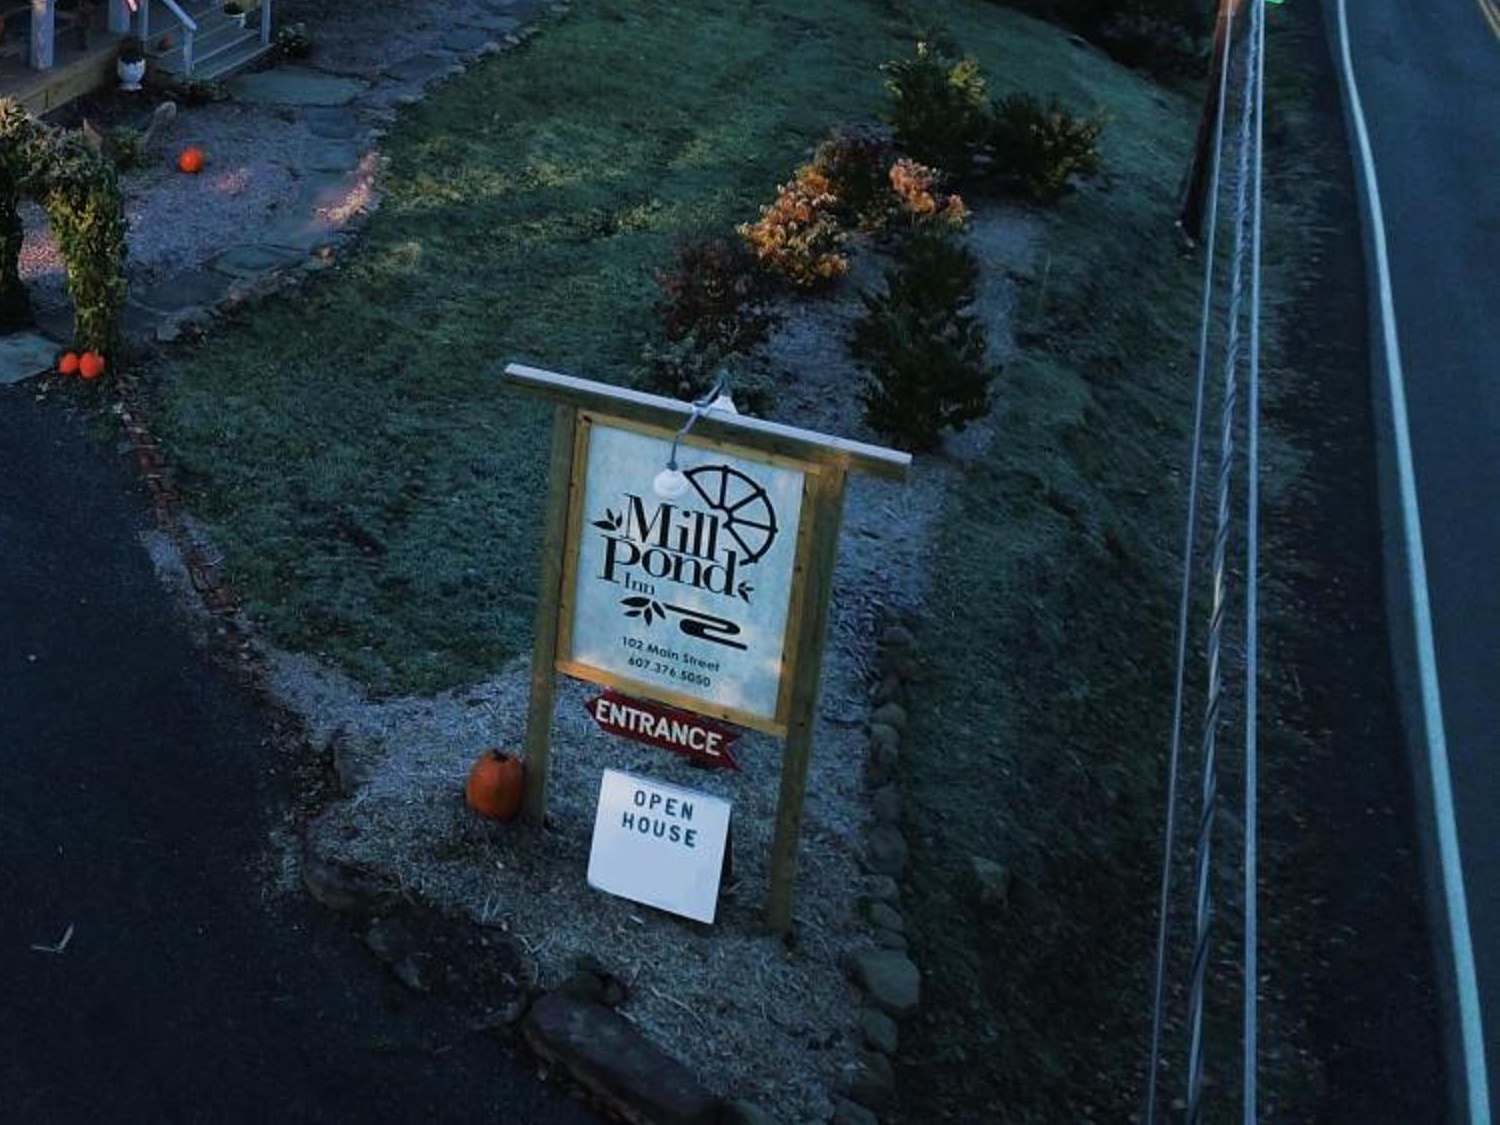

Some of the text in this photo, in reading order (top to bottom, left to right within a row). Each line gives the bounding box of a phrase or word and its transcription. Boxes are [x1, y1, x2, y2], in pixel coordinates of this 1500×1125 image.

[621, 492, 718, 563] Mill
[597, 533, 738, 598] Pond
[624, 572, 656, 596] Inn
[622, 636, 720, 673] 102 Main Street
[628, 656, 711, 688] 607.376.5050
[595, 698, 723, 756] ENTRANCE
[633, 790, 694, 821] OPEN
[621, 811, 698, 848] HOUSE
